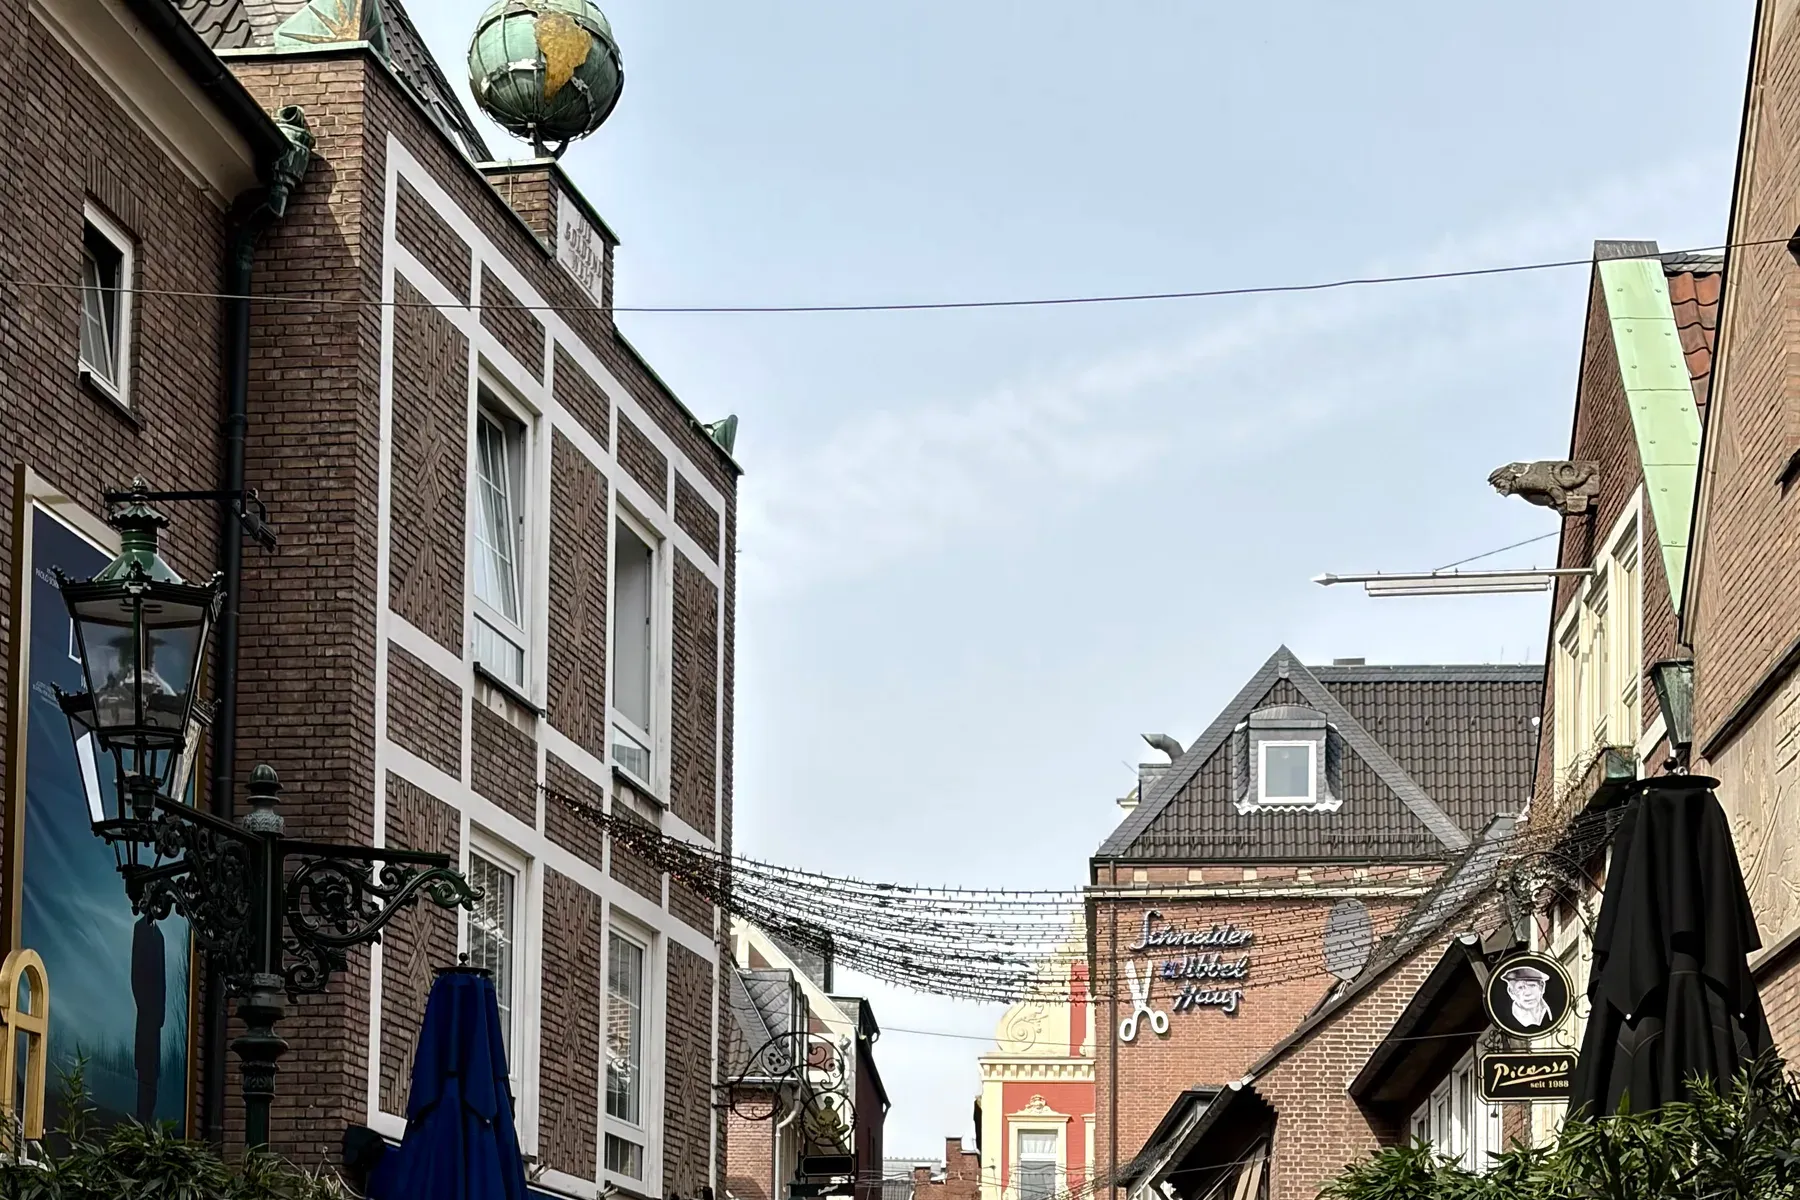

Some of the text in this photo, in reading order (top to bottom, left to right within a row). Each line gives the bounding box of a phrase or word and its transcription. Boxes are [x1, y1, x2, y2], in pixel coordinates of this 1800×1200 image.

[1129, 910, 1254, 949] Schneider
[1173, 985, 1242, 1012] Haus
[1491, 1060, 1569, 1092] Picasso
[1548, 1080, 1569, 1088] 1988
